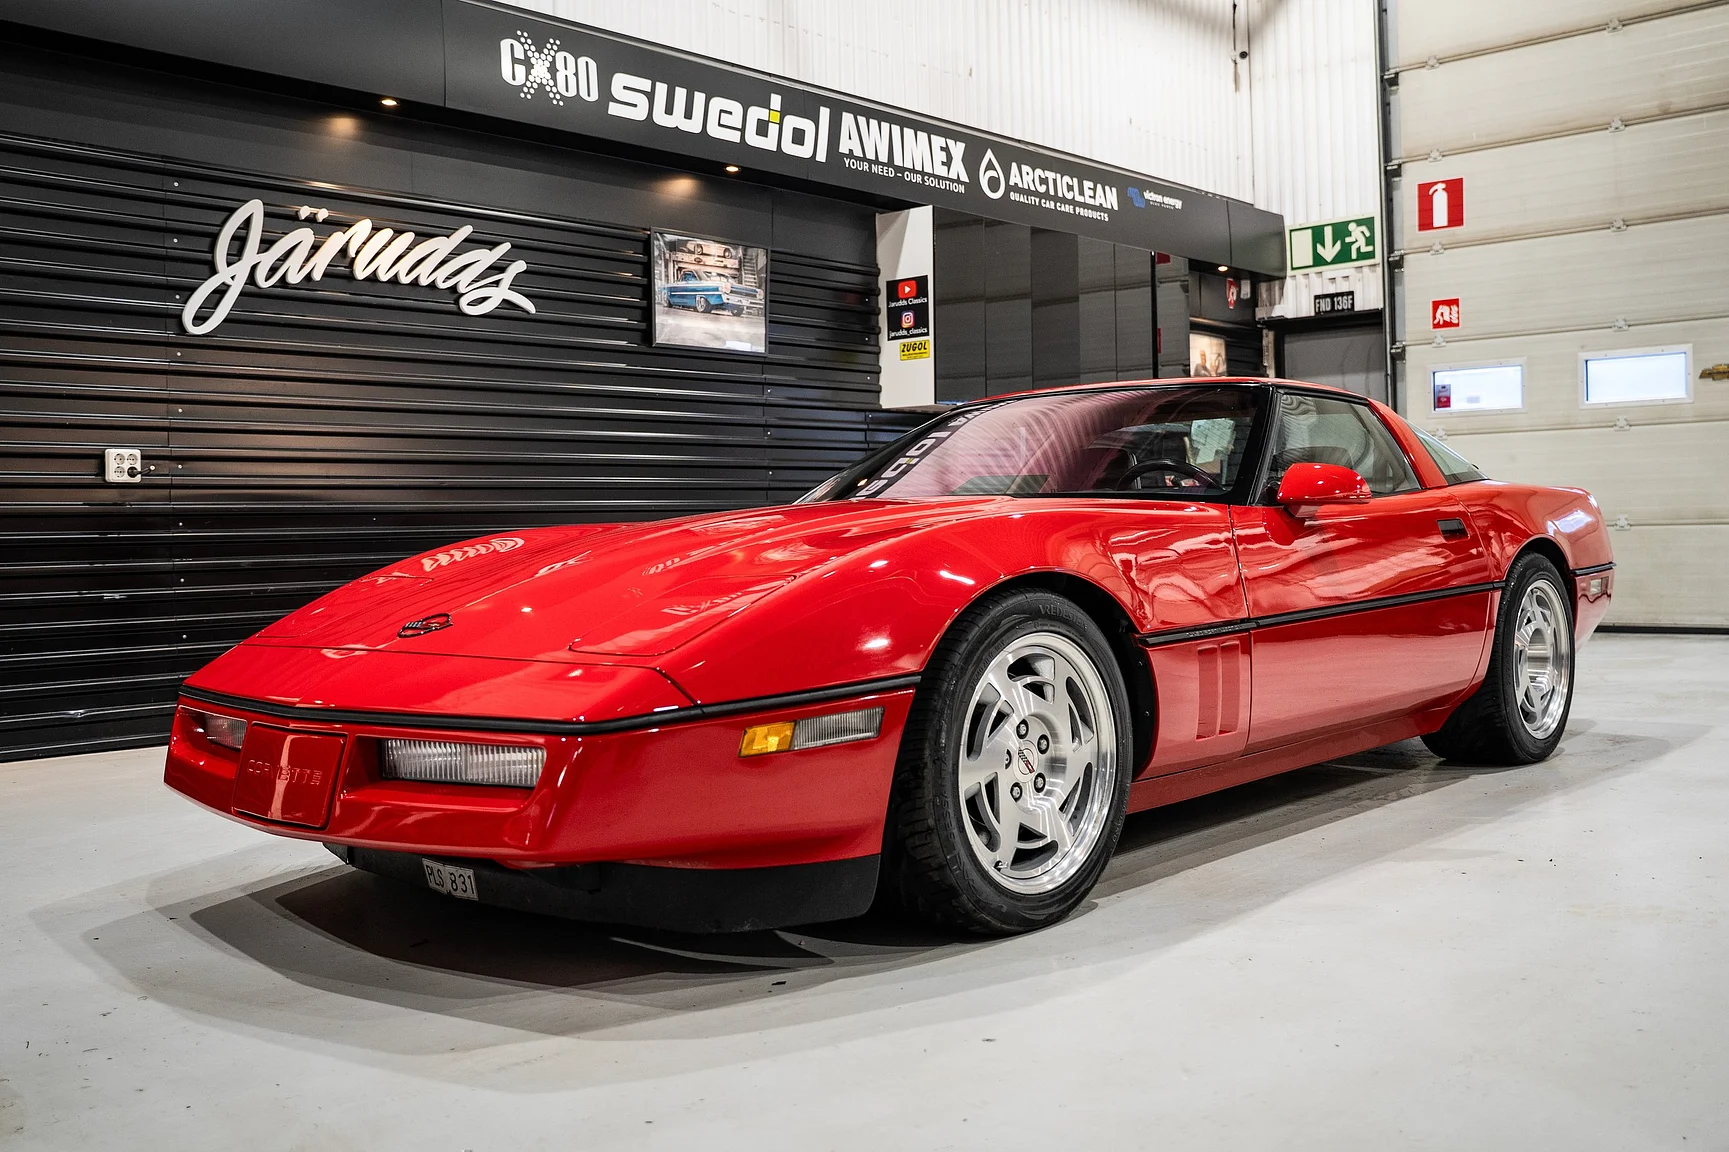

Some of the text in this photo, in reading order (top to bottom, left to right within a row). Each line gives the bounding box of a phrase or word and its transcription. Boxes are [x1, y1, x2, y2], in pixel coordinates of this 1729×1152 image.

[607, 72, 830, 163] swedol
[838, 111, 970, 183] AWIMEX
[843, 157, 869, 172] YOUR
[871, 163, 895, 178] NEED
[904, 171, 923, 184] OUR
[924, 175, 965, 194] SOLUTION
[1009, 161, 1119, 211] ARCTICLEAN
[1009, 191, 1109, 221] QUALITY CAR CARE PRODUCTS
[182, 198, 537, 336] Järudds
[1334, 295, 1353, 311] 136F
[901, 341, 928, 353] ZUGOL
[448, 871, 475, 895] 831
